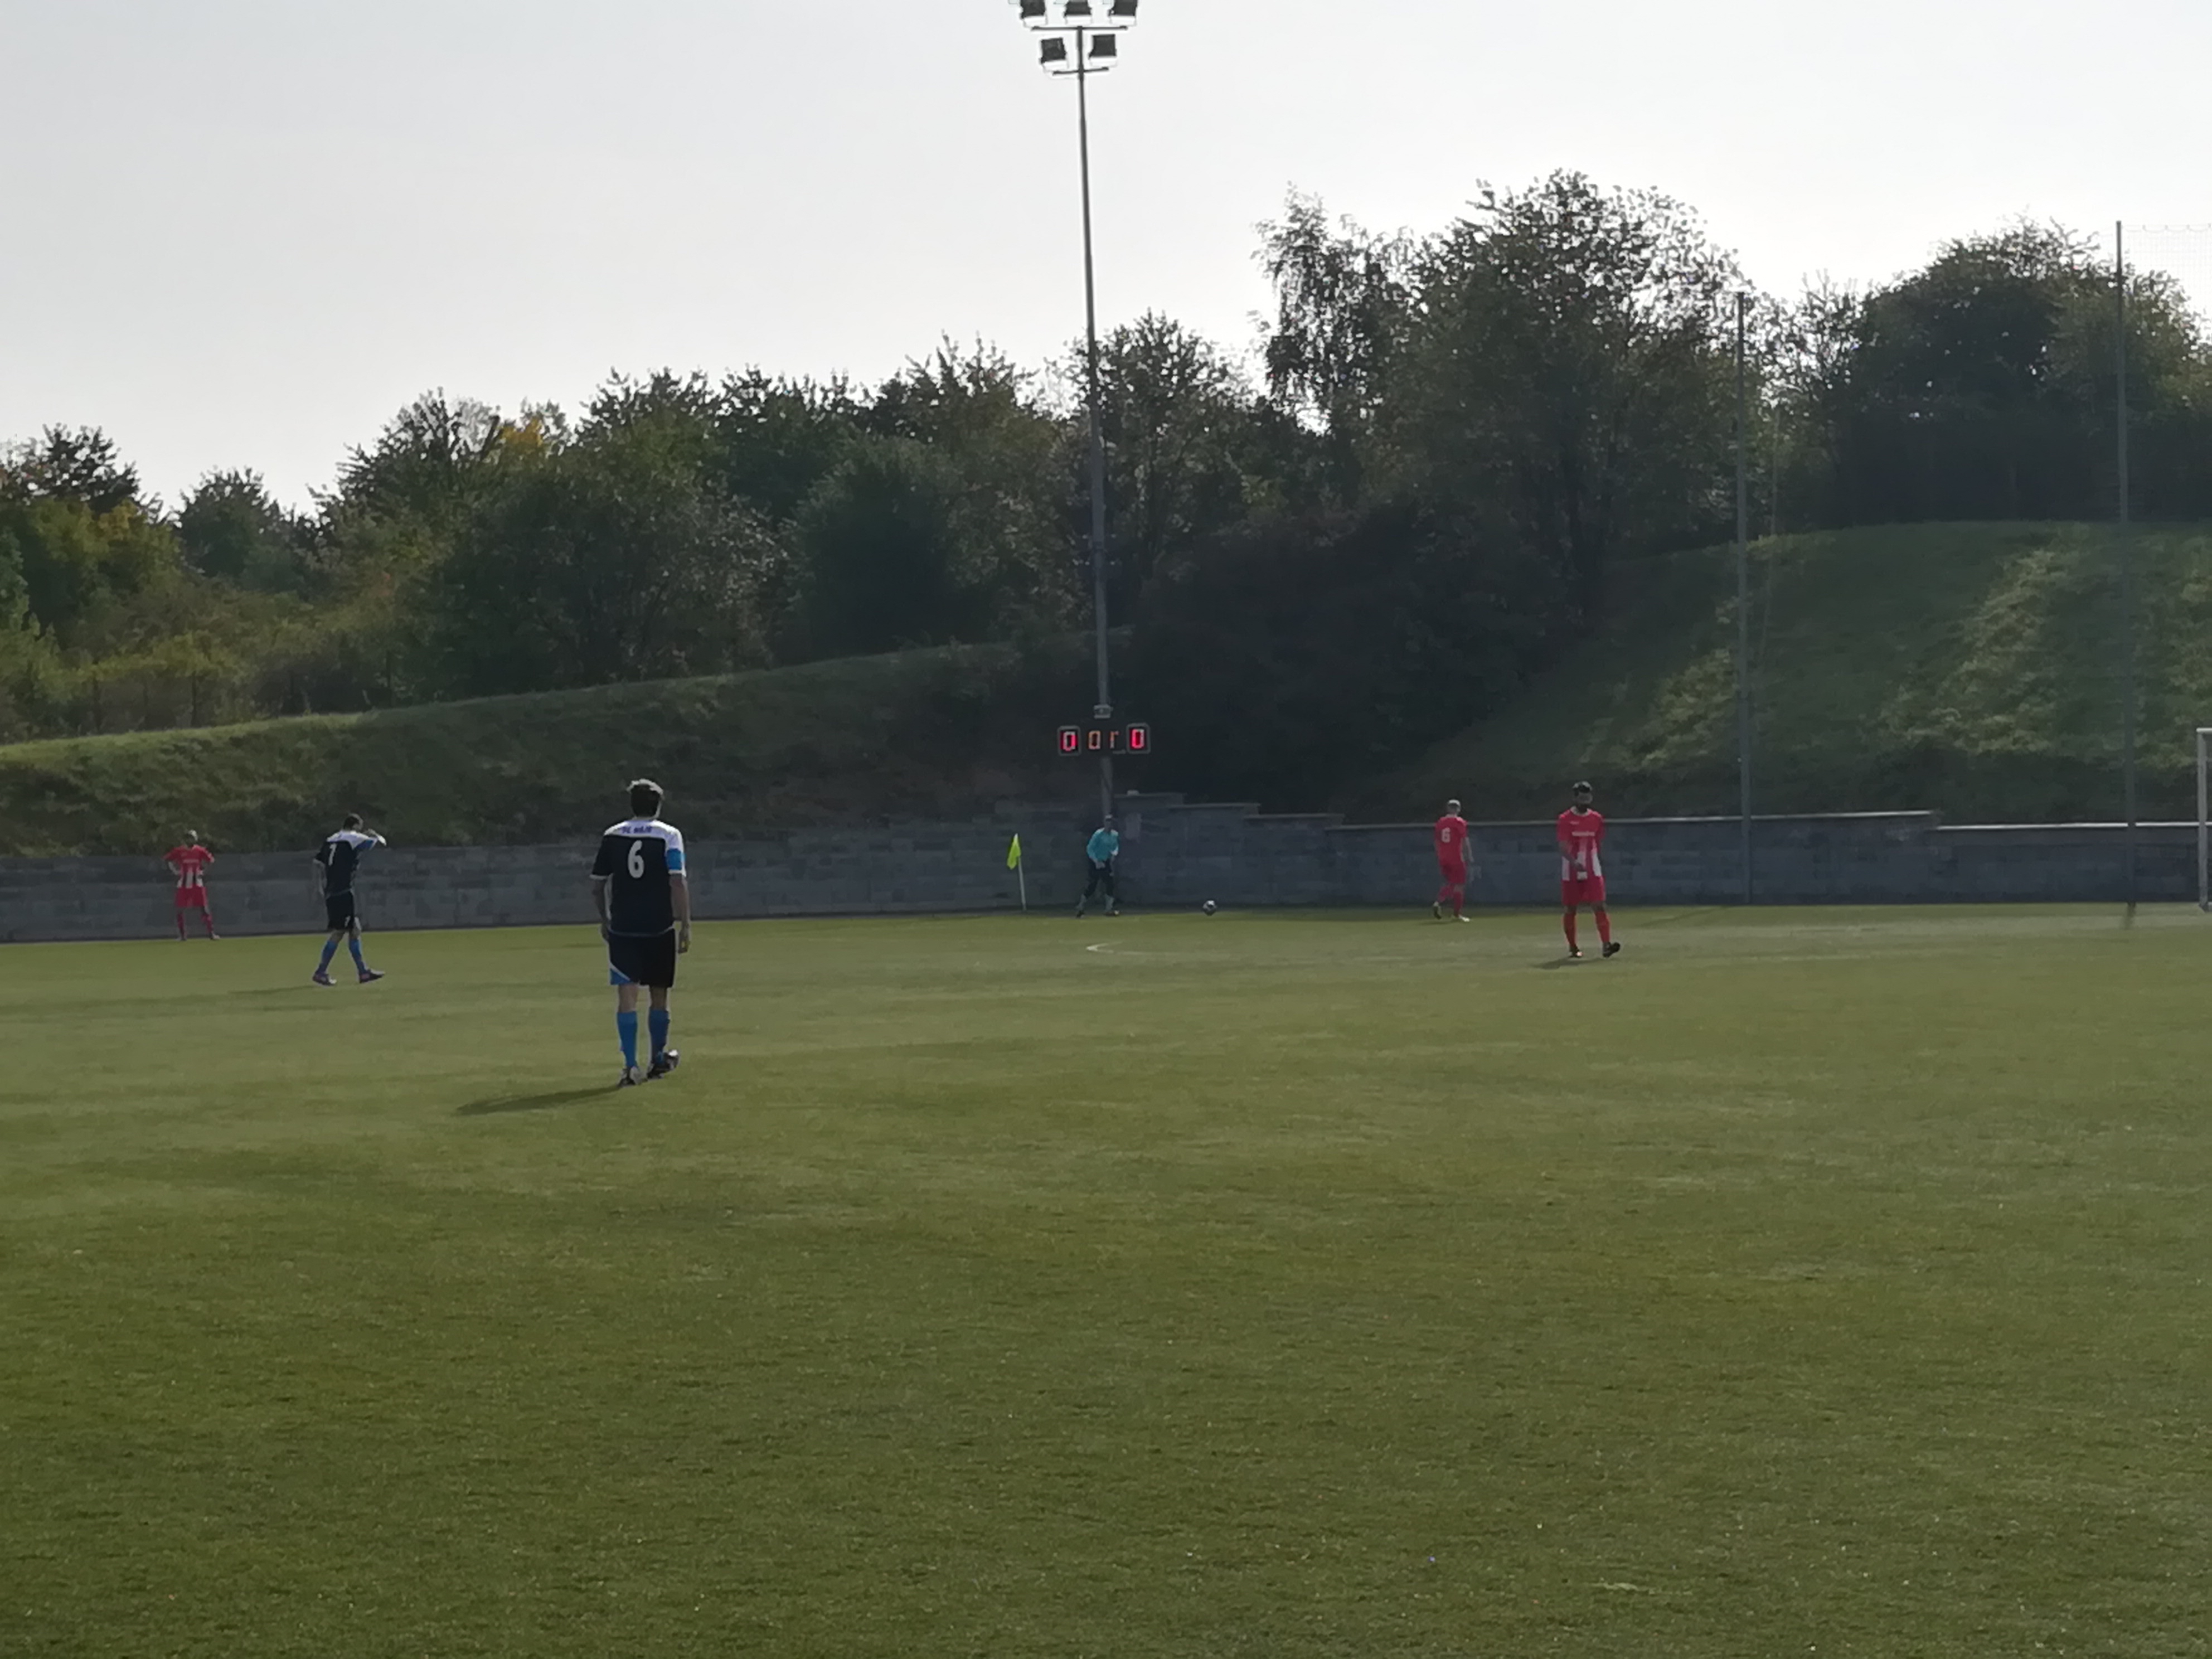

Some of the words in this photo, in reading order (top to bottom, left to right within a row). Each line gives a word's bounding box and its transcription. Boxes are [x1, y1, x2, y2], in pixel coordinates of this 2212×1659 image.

[1063, 731, 1076, 751] 0
[1131, 729, 1145, 749] 0
[628, 840, 644, 879] 6
